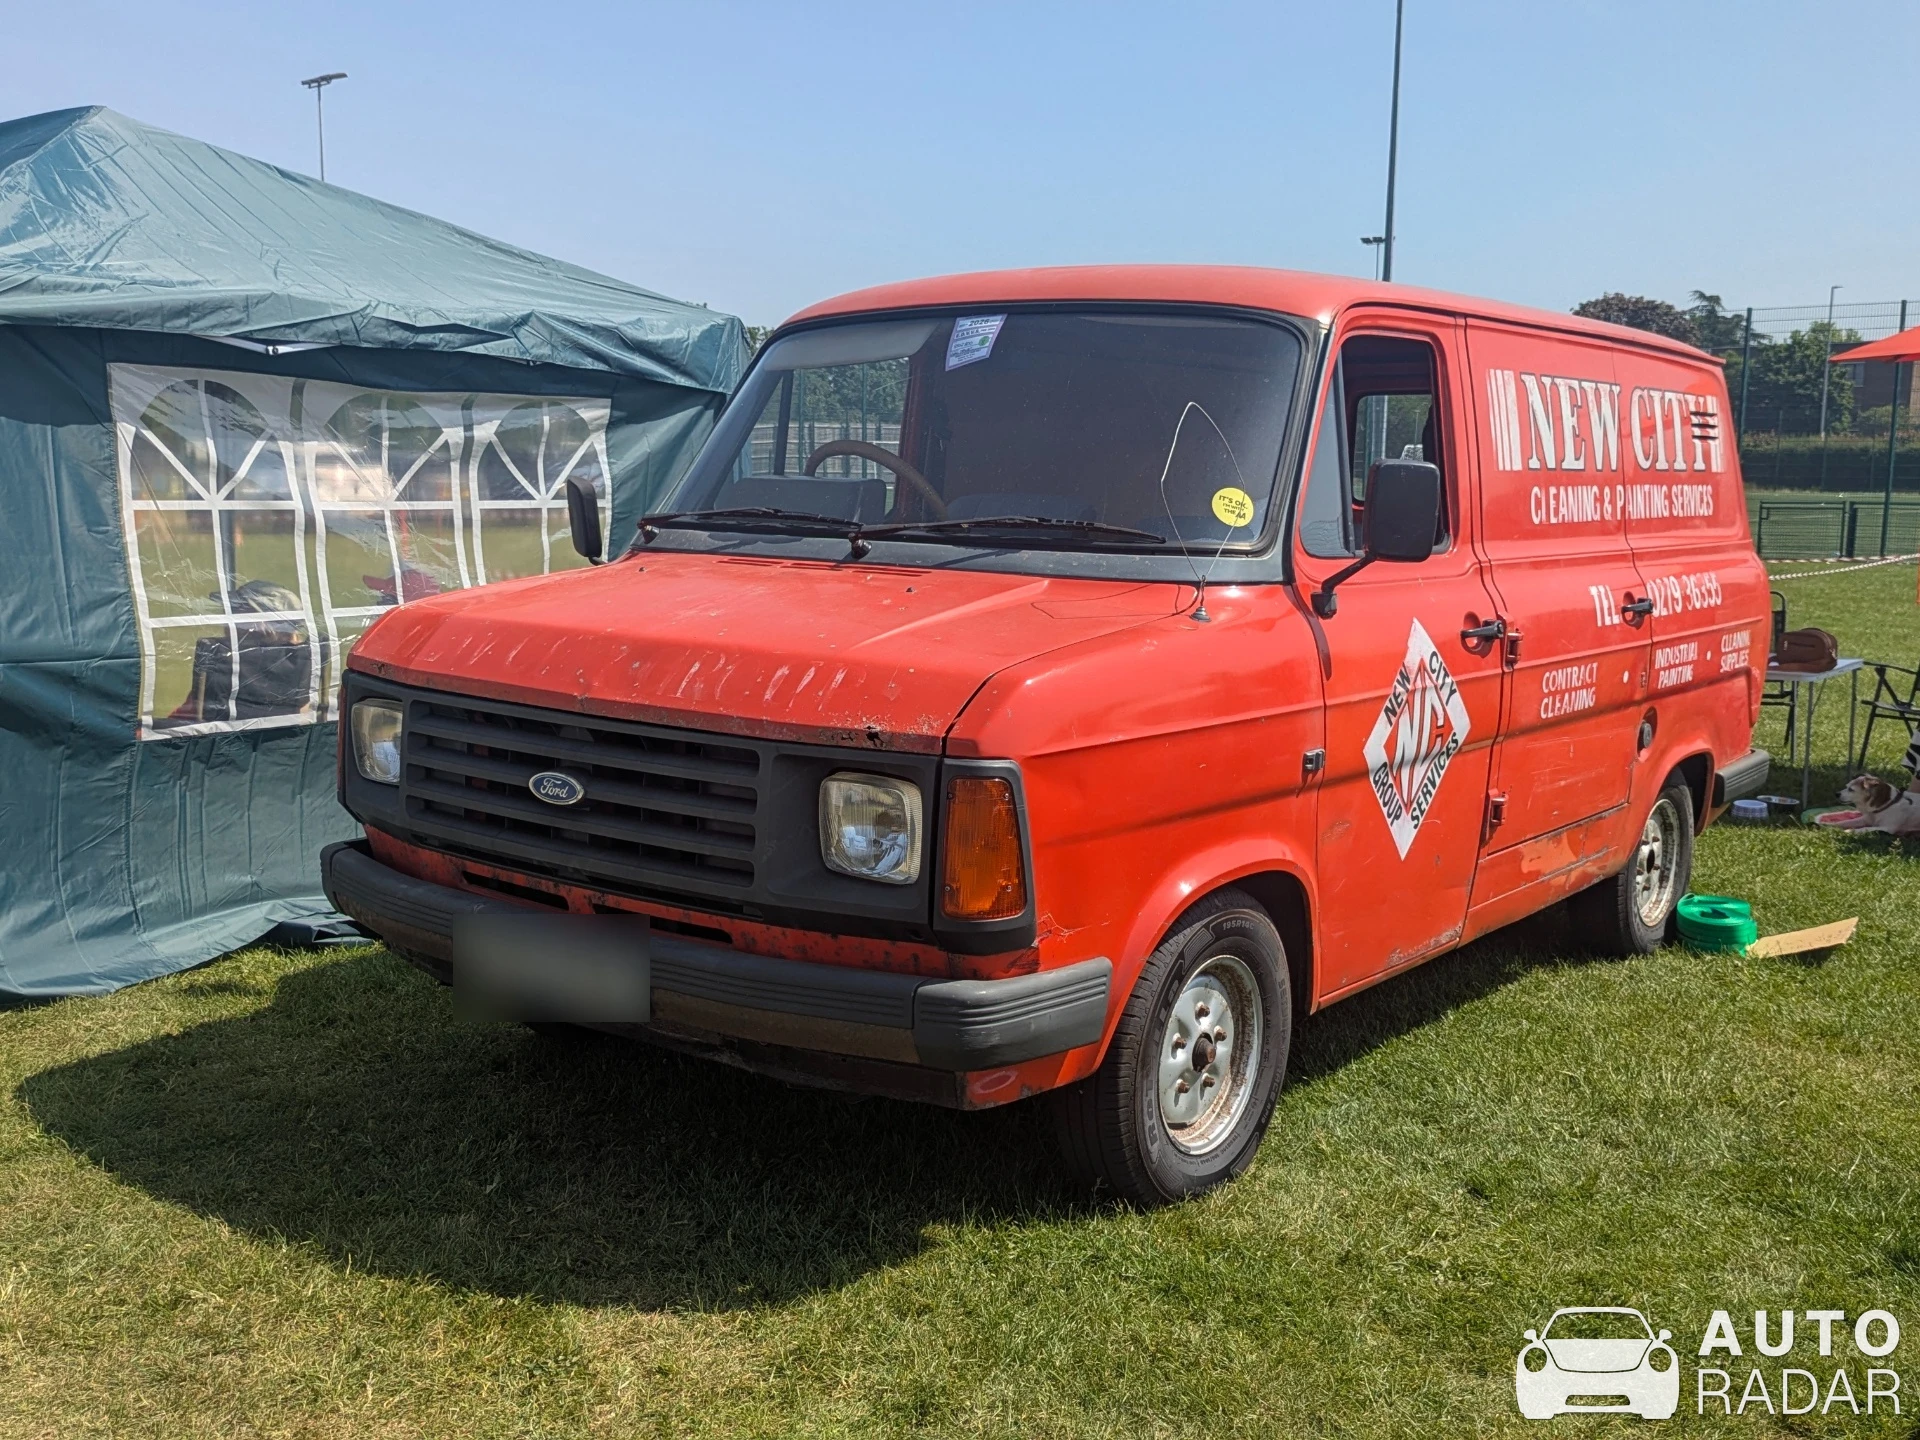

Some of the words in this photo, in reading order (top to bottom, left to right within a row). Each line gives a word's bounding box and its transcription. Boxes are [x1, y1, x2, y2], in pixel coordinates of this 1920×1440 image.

[1520, 372, 1621, 472] NEW
[1629, 386, 1709, 473] CITY
[1219, 495, 1233, 503] IT'S
[1530, 485, 1600, 525] CLEANING
[1603, 485, 1612, 521] &
[1616, 484, 1669, 520] PAINTING
[1671, 484, 1713, 517] SERVICES
[1646, 575, 1682, 618] 0279
[1681, 571, 1722, 611] 36355
[1655, 641, 1698, 669] INDUSTRIAL
[1720, 649, 1749, 673] SUPPLIES
[1384, 662, 1411, 727] NEW
[1429, 651, 1457, 706] CITY
[1542, 662, 1598, 693] CONTRACT
[1658, 664, 1694, 689] PAINTING
[1540, 686, 1596, 719] CLEANING
[540, 777, 569, 798] Ford
[1373, 761, 1403, 827] GROUP
[1410, 732, 1459, 829] SERVICES
[1222, 919, 1254, 931] 195R14C
[1144, 979, 1180, 1148] ROTLLA
